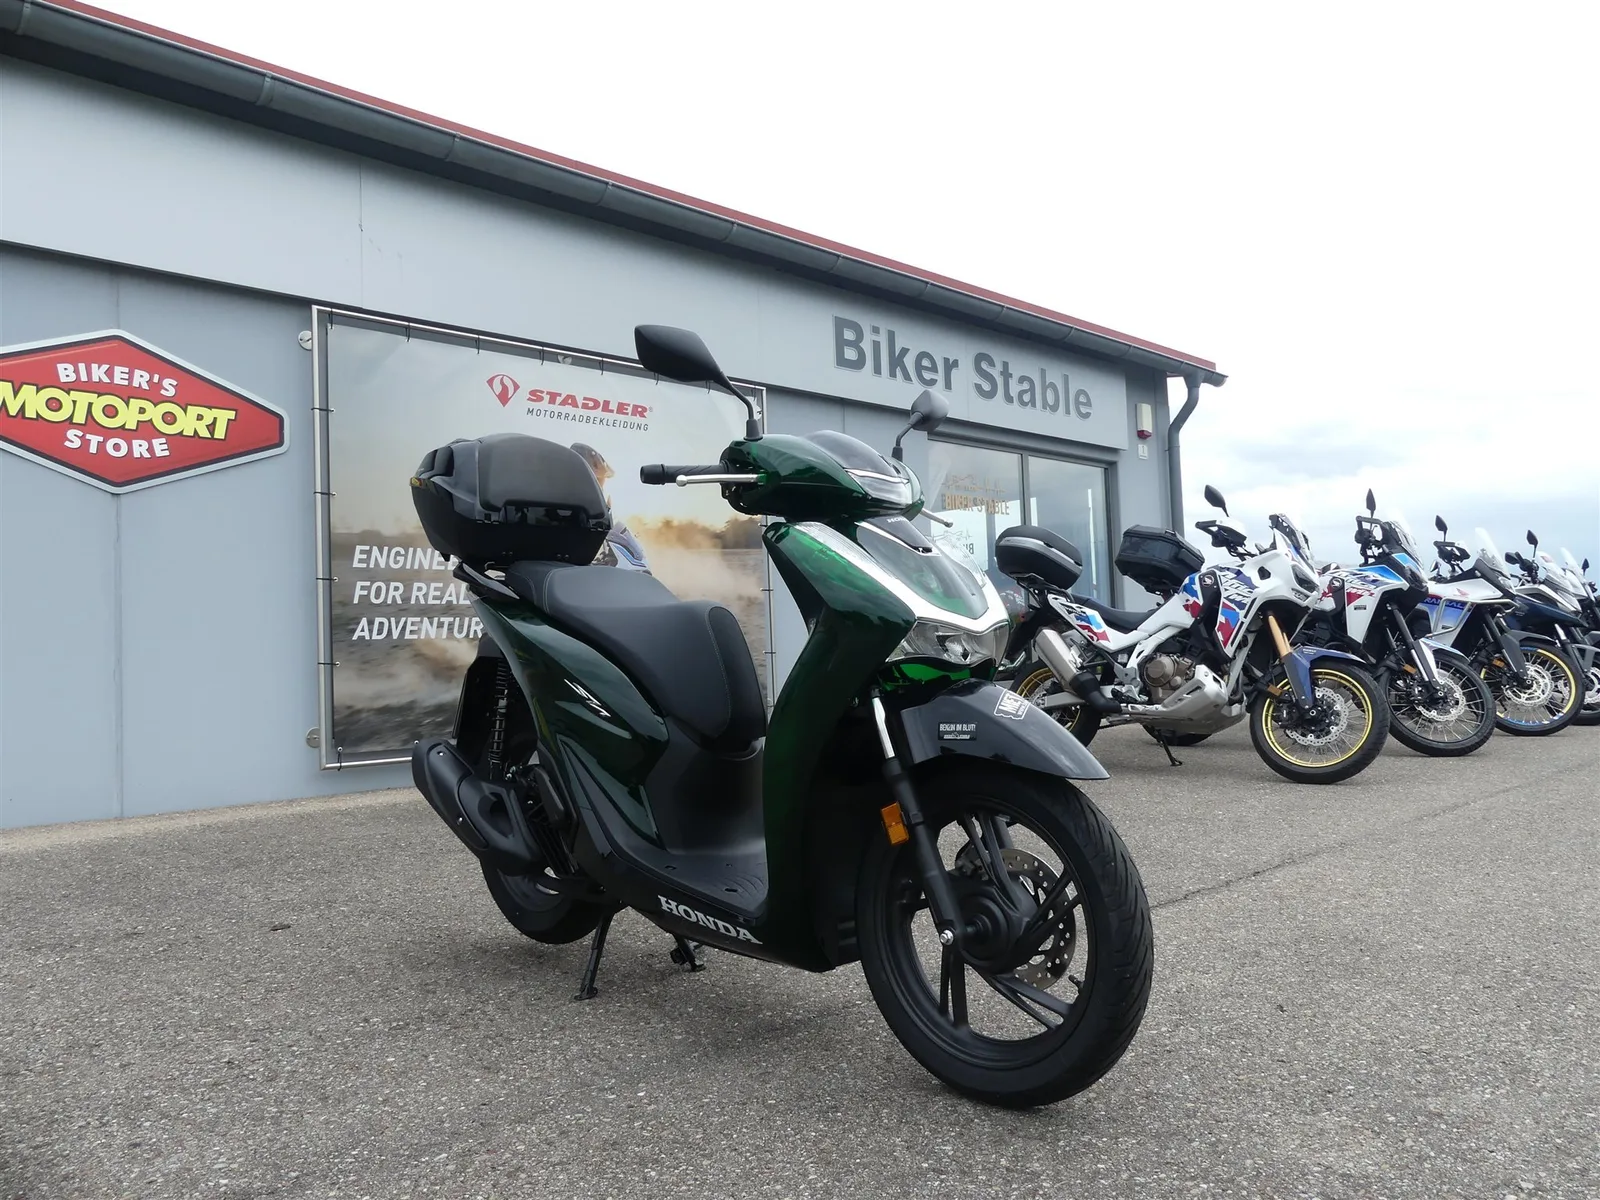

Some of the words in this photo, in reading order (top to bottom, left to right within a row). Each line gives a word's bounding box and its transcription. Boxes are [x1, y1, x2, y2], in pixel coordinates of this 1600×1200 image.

[56, 363, 178, 397] BIKER'S
[833, 315, 959, 391] Biker
[973, 351, 1093, 420] Stable
[0, 380, 236, 440] MOTOPORT
[526, 407, 649, 432] MOTORRADBEKLEIDUNG
[64, 428, 169, 458] STORE
[353, 581, 404, 604] FOR
[410, 582, 471, 605] REAL
[657, 894, 763, 945] HONDA
